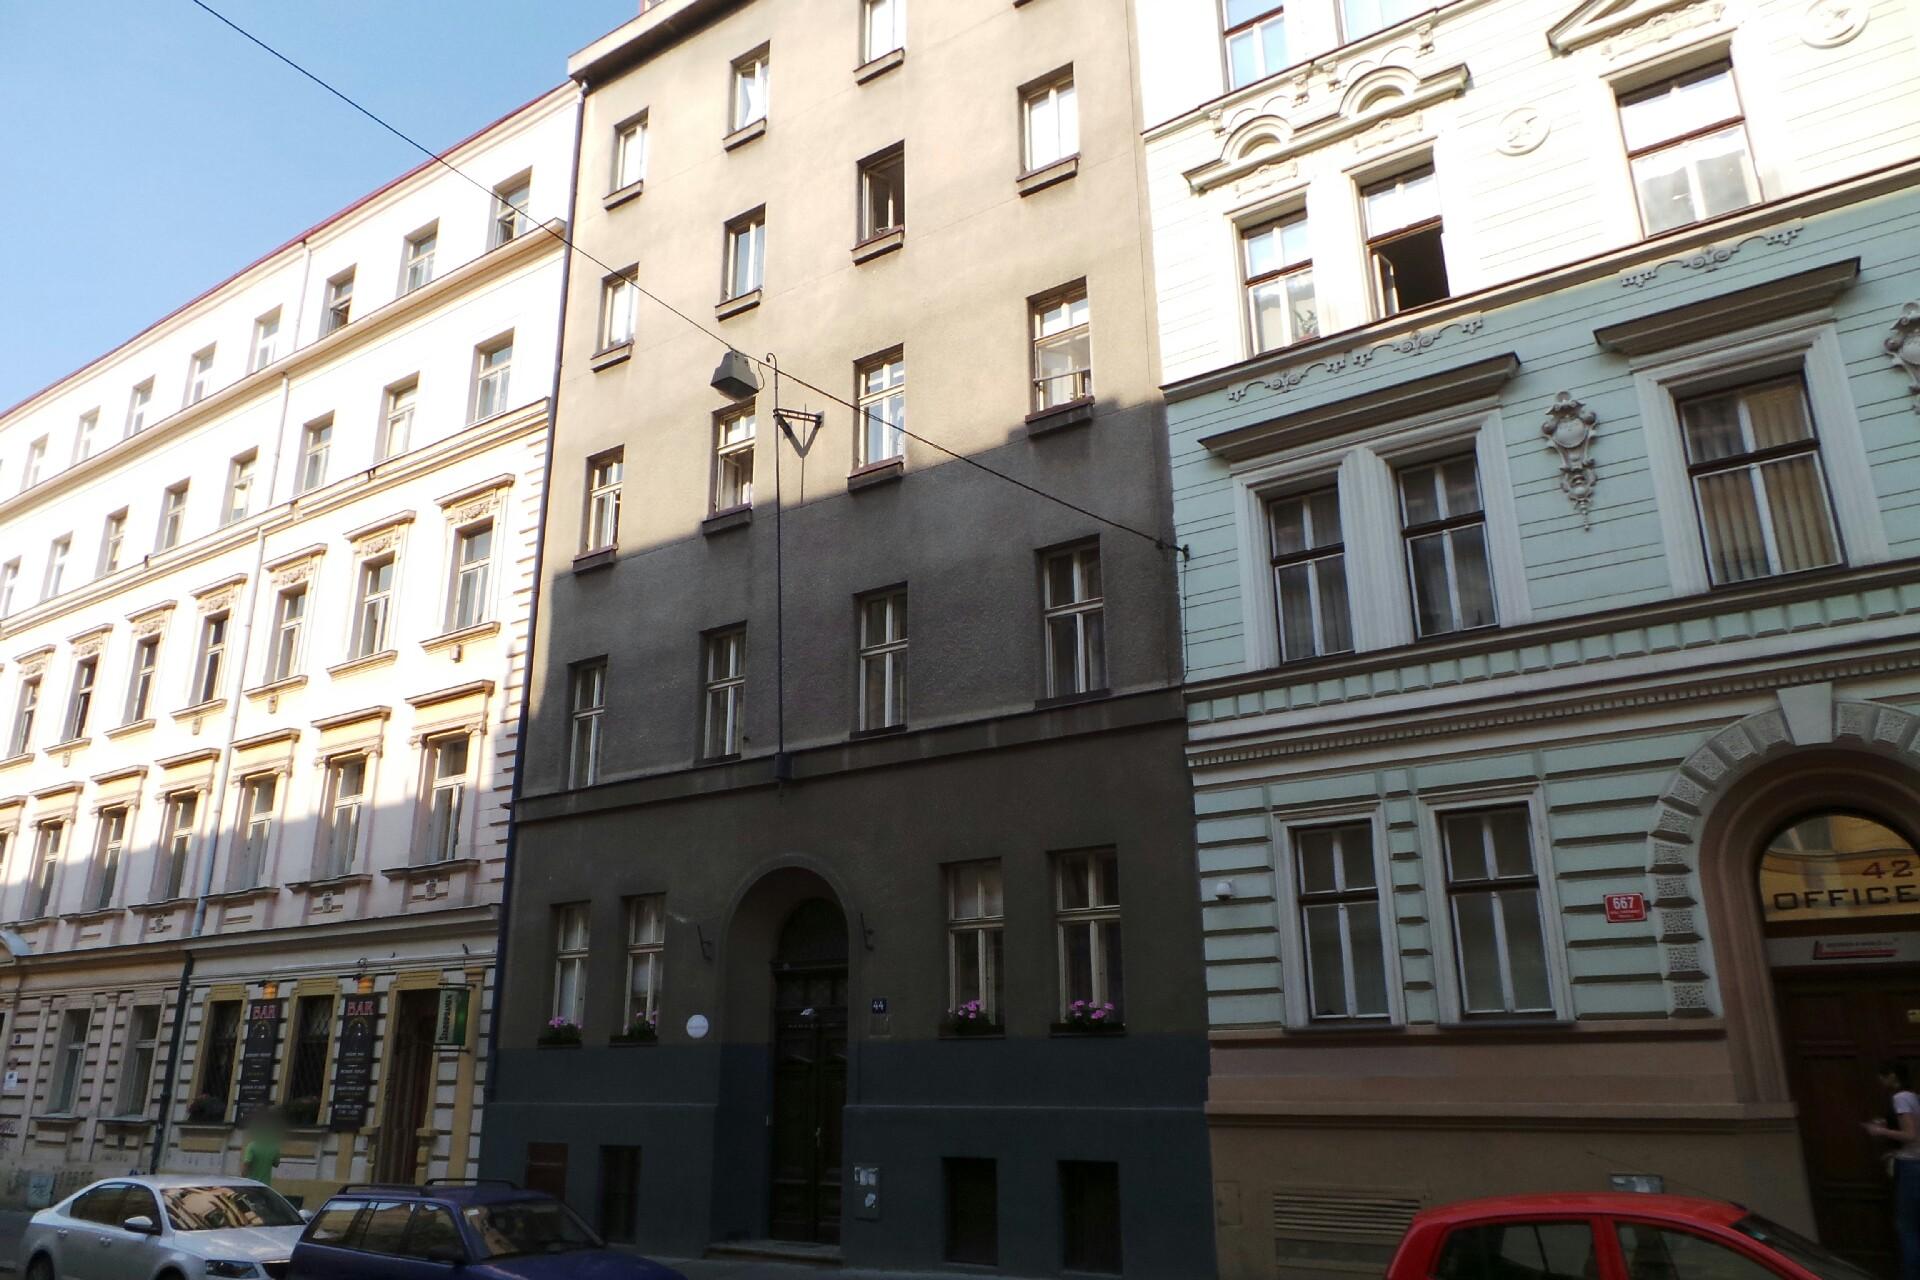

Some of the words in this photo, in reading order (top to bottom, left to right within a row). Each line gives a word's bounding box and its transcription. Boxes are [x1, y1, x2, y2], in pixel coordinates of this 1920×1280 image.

[1861, 860, 1914, 879] 42
[1612, 895, 1634, 910] 667
[1773, 884, 1919, 910] OFFICE
[252, 1005, 278, 1020] BAR
[347, 1001, 374, 1016] BAR
